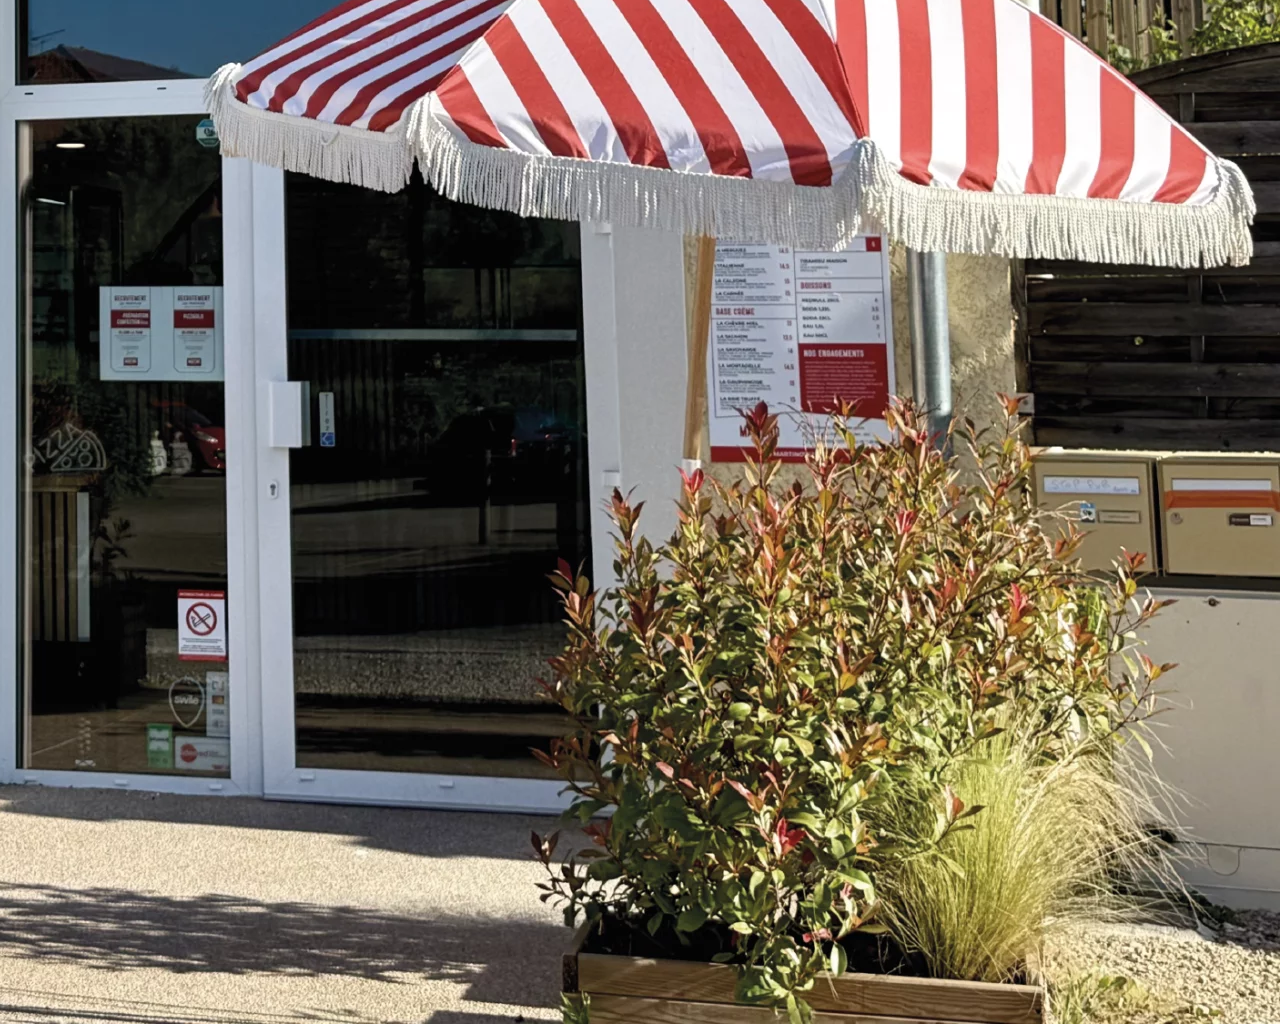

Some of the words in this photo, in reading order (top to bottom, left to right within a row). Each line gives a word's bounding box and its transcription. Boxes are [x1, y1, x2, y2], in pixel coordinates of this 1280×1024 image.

[715, 308, 732, 316] BASE
[803, 349, 817, 358] NOS
[818, 349, 865, 358] ENGAGEMENTS
